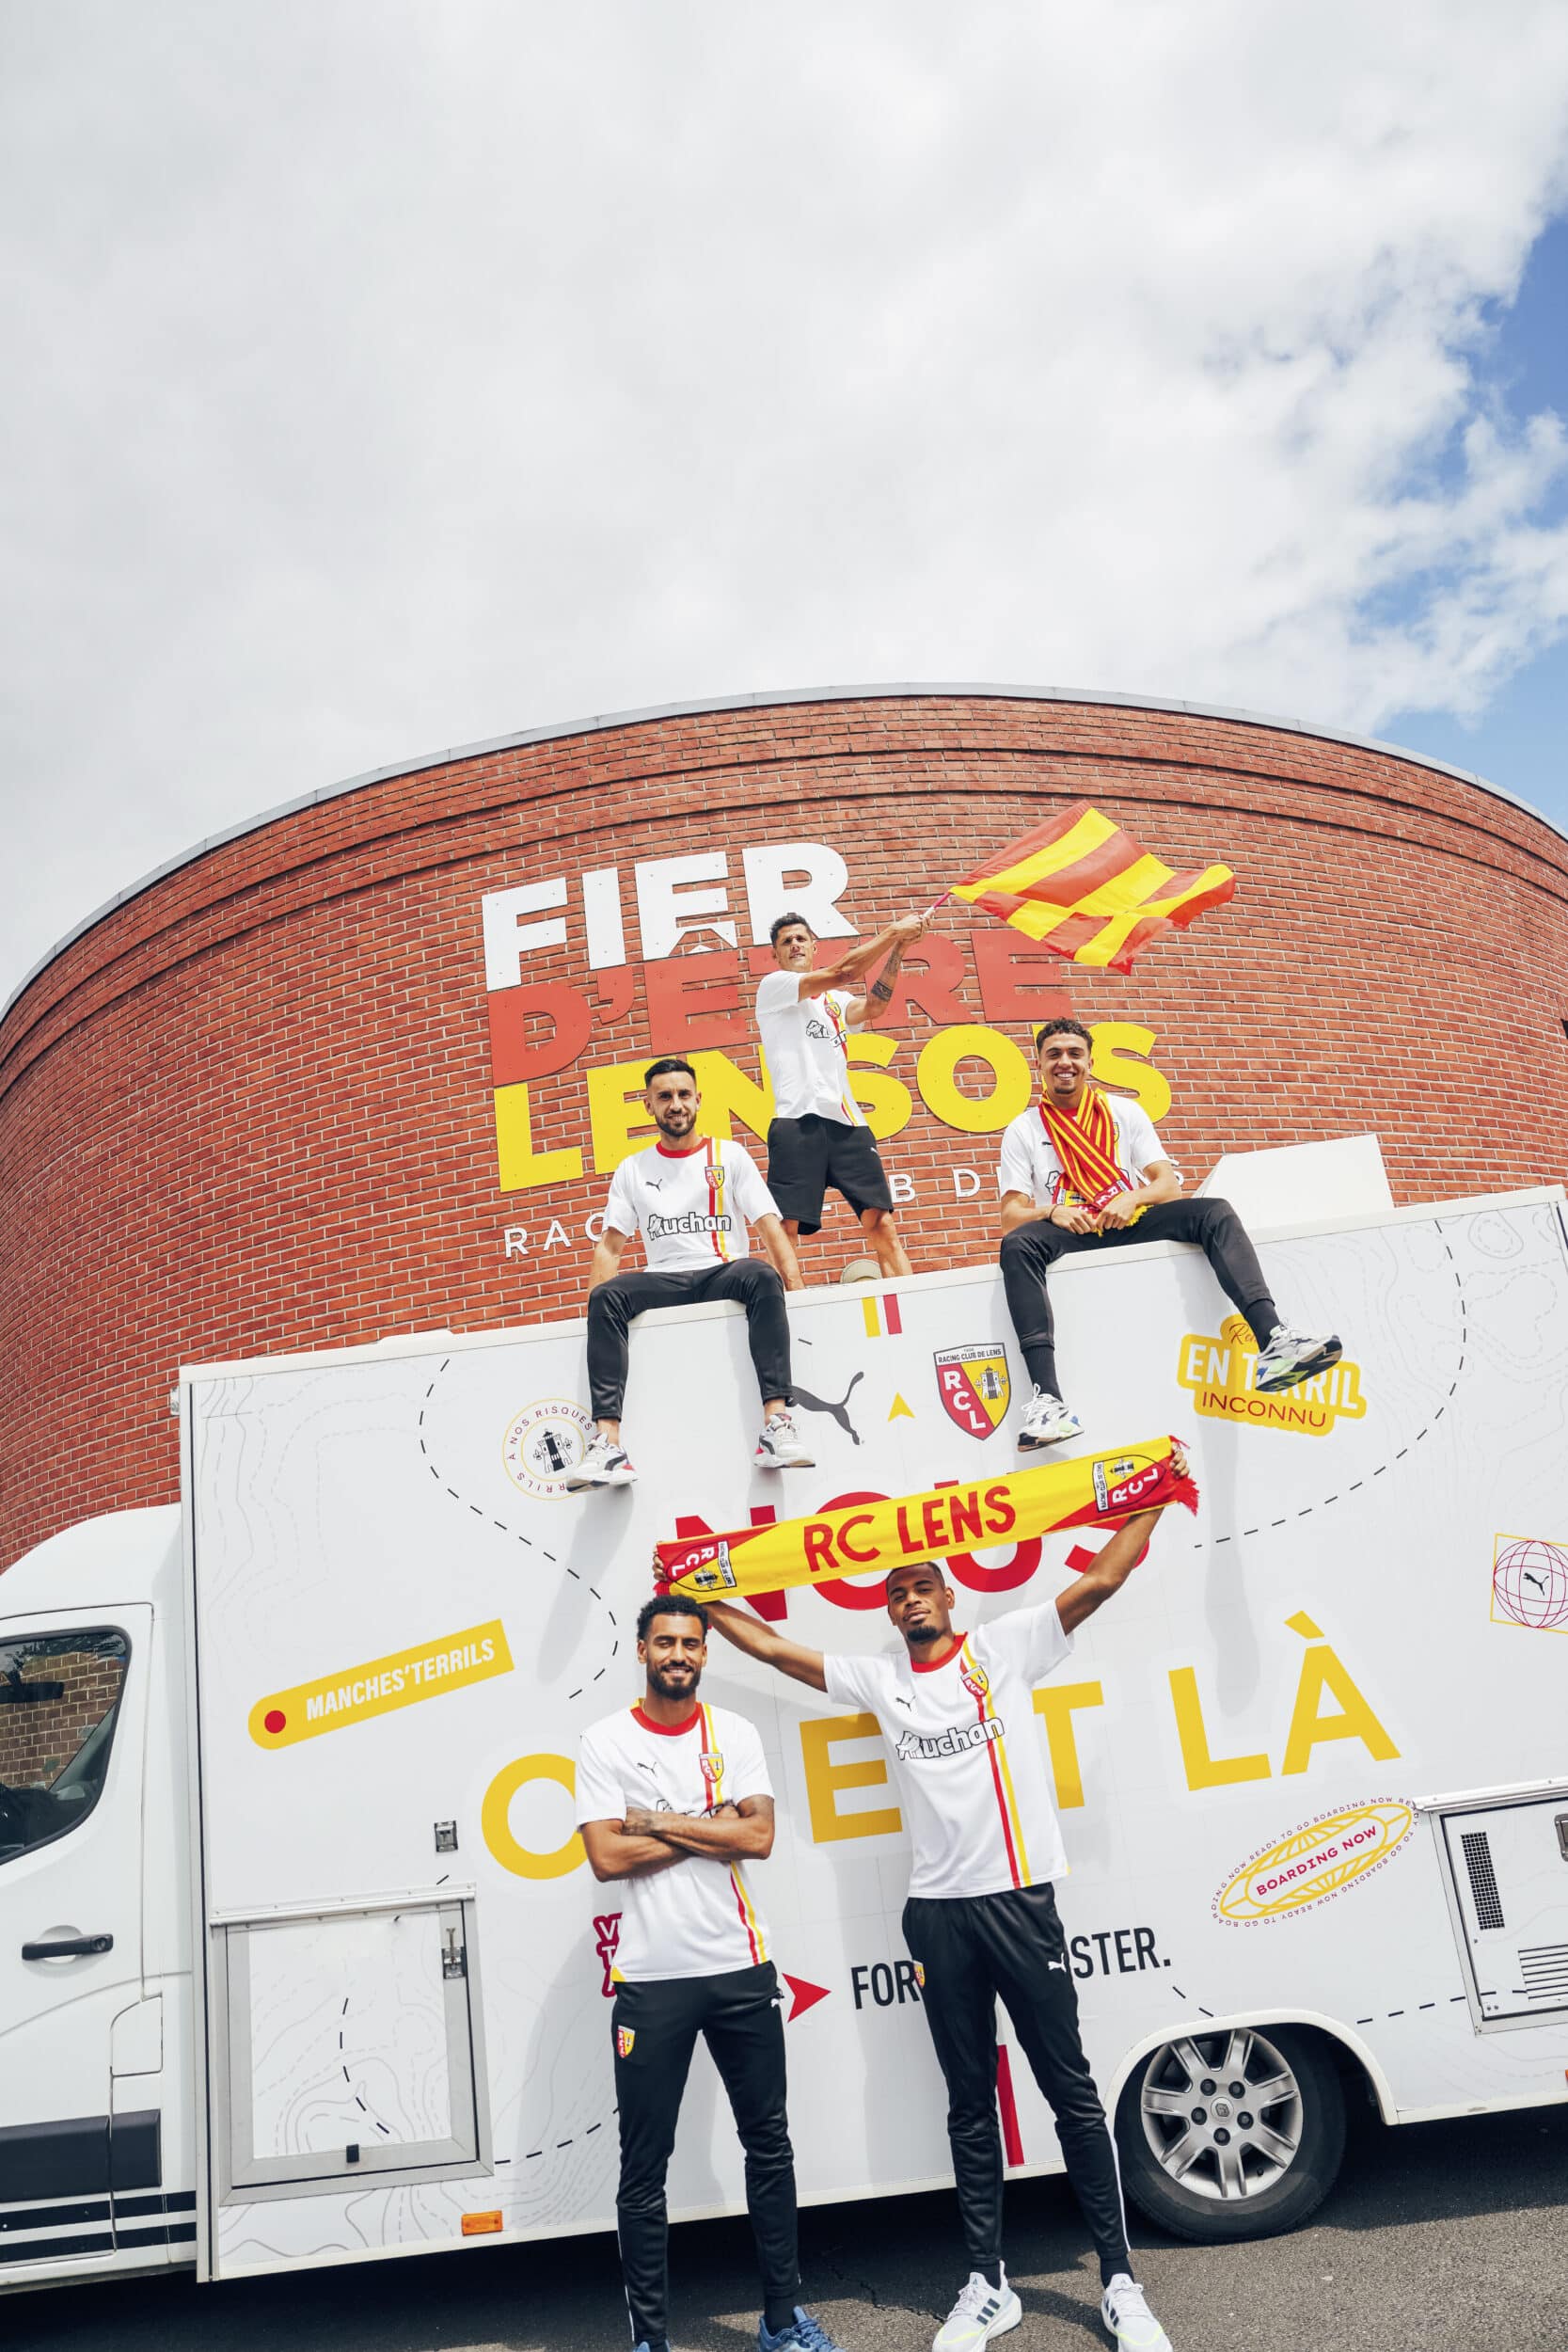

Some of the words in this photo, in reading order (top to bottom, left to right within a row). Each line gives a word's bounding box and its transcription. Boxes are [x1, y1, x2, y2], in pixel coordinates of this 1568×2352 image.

[481, 842, 862, 993] FIER
[494, 1022, 1172, 1193] LENSOS
[503, 1212, 611, 1259] RAC
[647, 1212, 732, 1241] Auchan
[943, 1370, 987, 1430] RCL
[1185, 1343, 1231, 1387] EN
[1243, 1352, 1358, 1409] TRIL
[510, 1419, 530, 1445] NOS
[535, 1406, 594, 1432] RISQUES
[1202, 1391, 1327, 1427] INCONNU
[516, 1471, 565, 1493] RRILS
[804, 1514, 881, 1573] RC
[897, 1486, 1016, 1554] LENS
[306, 1638, 496, 1721] MANCHES'TERRILS
[799, 1680, 1104, 1844] ET
[1167, 1610, 1402, 1791] LÀ
[895, 1717, 1006, 1761] Auchan
[1280, 1830, 1293, 1839] TO
[1296, 1821, 1310, 1831] GO
[1256, 1847, 1338, 1897] BOARDING
[1342, 1825, 1377, 1852] NOW
[1070, 1927, 1172, 1979] STER.
